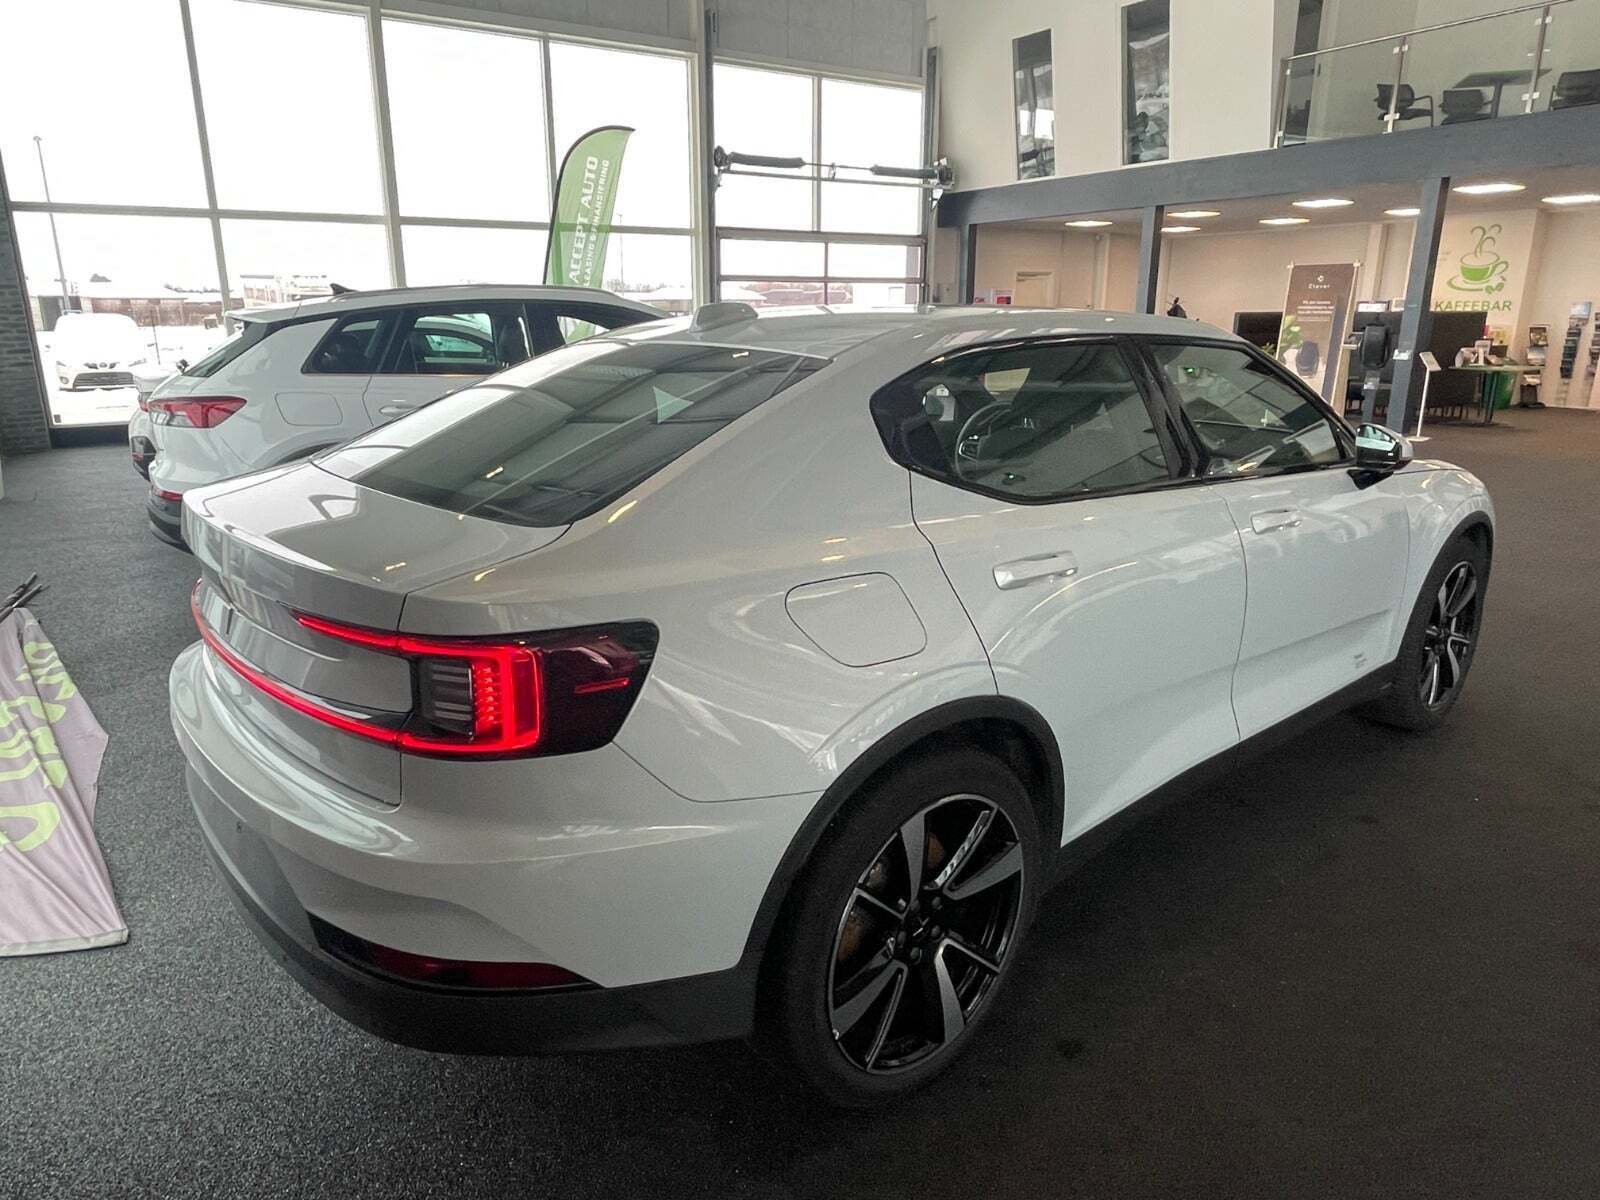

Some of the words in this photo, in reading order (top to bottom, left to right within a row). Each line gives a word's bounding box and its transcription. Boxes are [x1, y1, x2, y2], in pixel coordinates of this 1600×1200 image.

[569, 213, 588, 283] ACCEPT
[581, 156, 598, 208] AUTO
[584, 242, 595, 286] LEASING
[1435, 300, 1512, 311] KAFFEBAR
